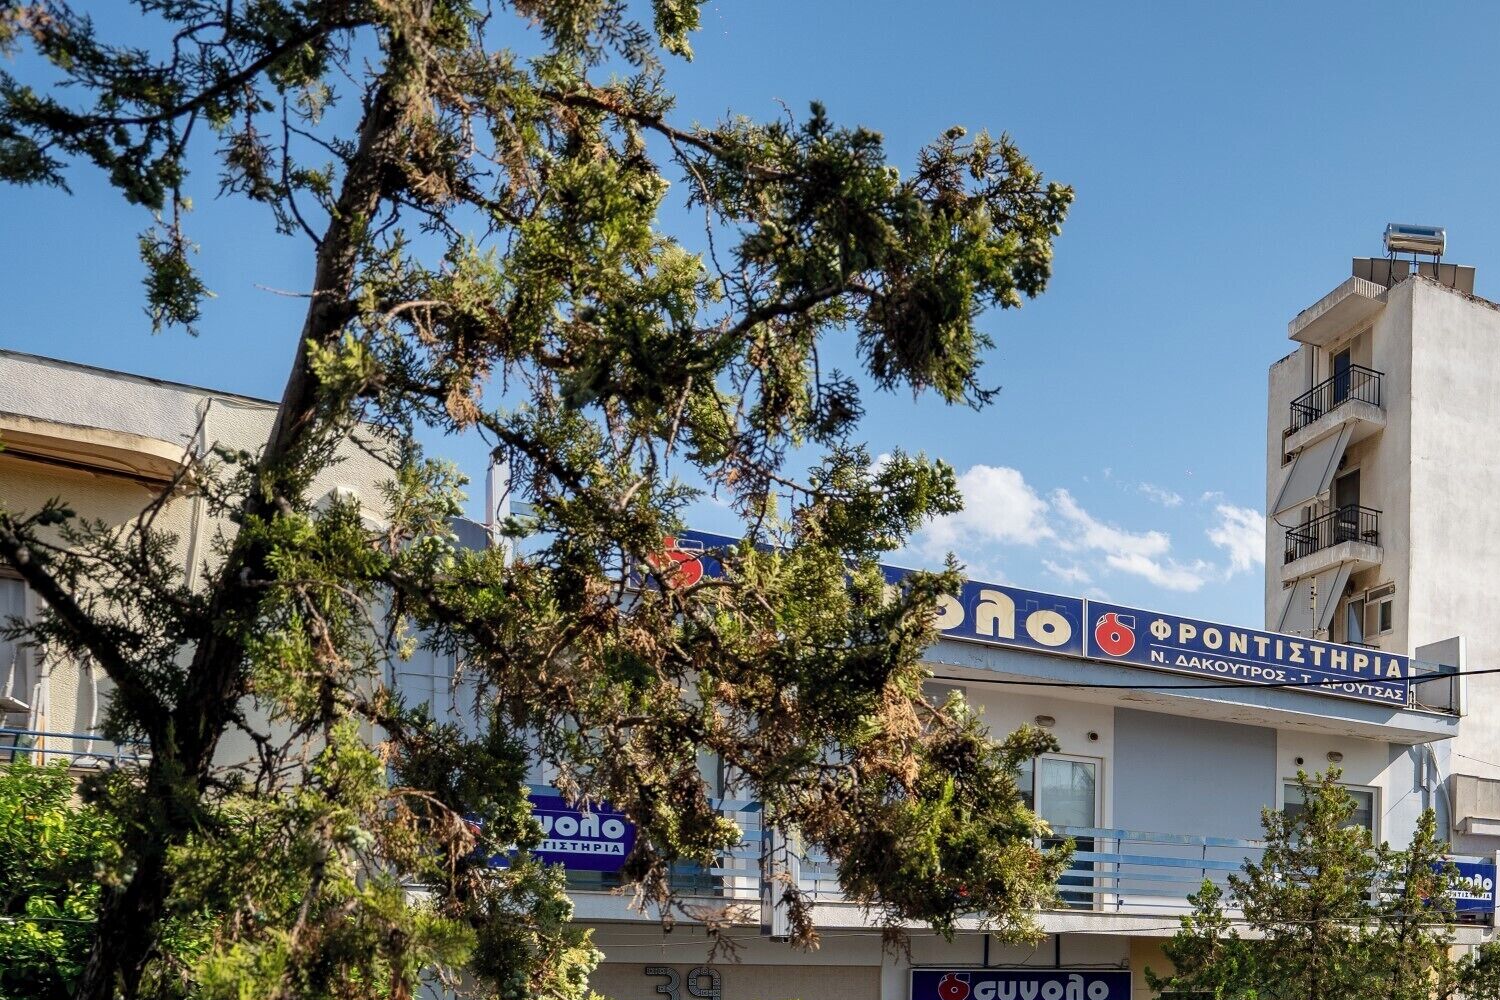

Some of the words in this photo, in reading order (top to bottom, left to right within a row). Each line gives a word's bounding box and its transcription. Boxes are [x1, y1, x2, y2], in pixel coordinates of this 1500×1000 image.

[1150, 618, 1402, 679] ΦΡΟΝΤΙΣΤΗΡΙΑ
[1175, 655, 1287, 682] ΔΑΚΟΥΤΡΟΣ
[1320, 678, 1404, 701] ΔΡΟΥΤΣΑΣ
